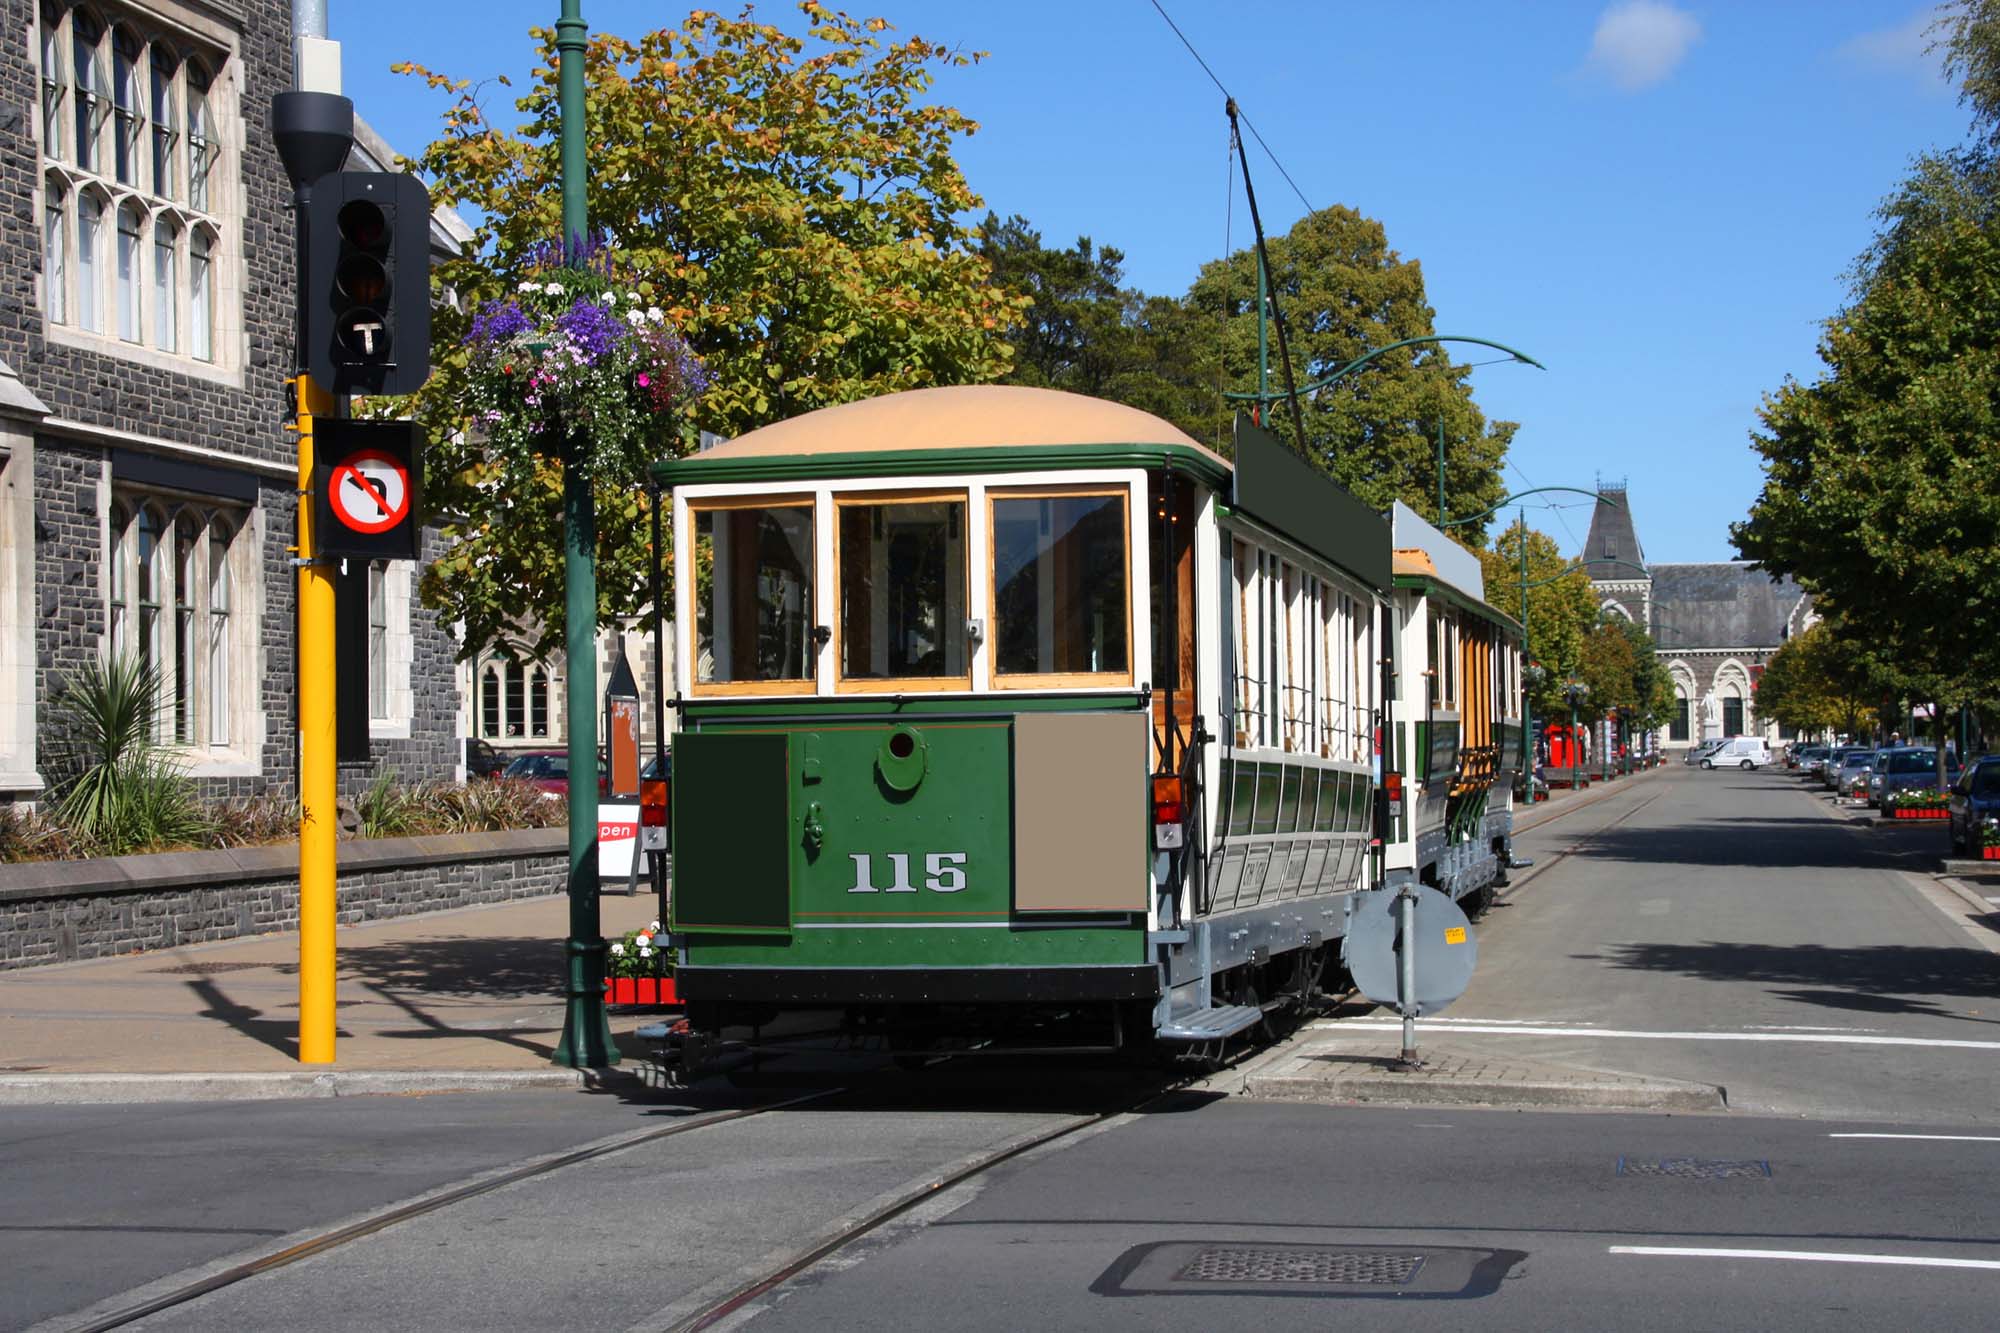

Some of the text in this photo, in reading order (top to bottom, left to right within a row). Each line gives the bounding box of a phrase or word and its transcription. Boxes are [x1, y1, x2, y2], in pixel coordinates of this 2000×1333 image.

[353, 323, 382, 354] T
[598, 826, 631, 838] pen
[847, 852, 967, 892] 115
